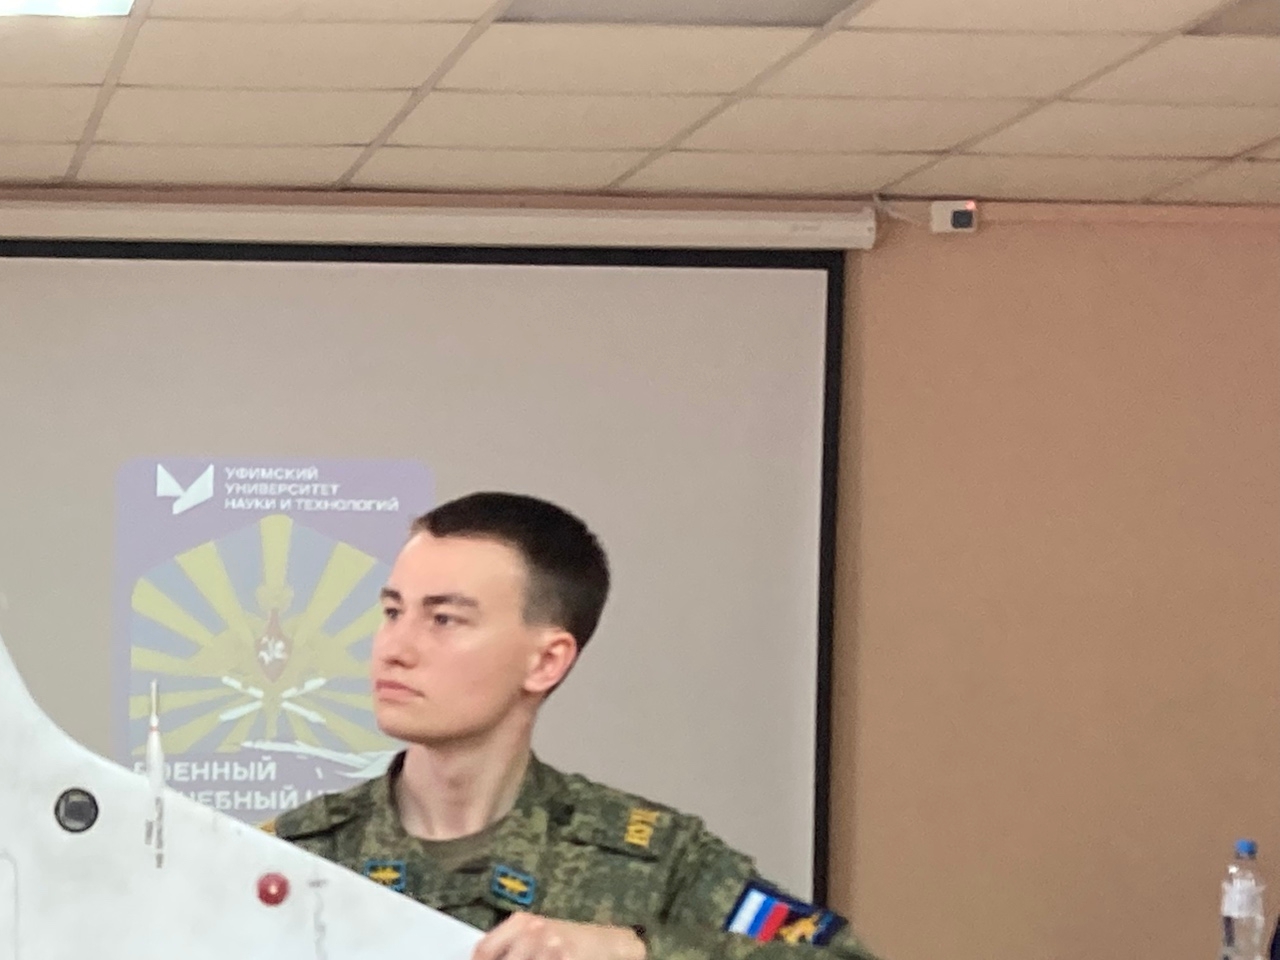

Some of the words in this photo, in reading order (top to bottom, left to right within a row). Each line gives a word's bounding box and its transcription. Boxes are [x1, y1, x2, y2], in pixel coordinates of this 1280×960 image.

[224, 465, 319, 480] УФИМСКИЙ
[224, 482, 341, 497] УНИВЕРСИТЕТ
[224, 498, 276, 512] НАУКИ
[279, 498, 293, 512] И
[295, 497, 400, 512] ТЕХНОЛОГИЙ
